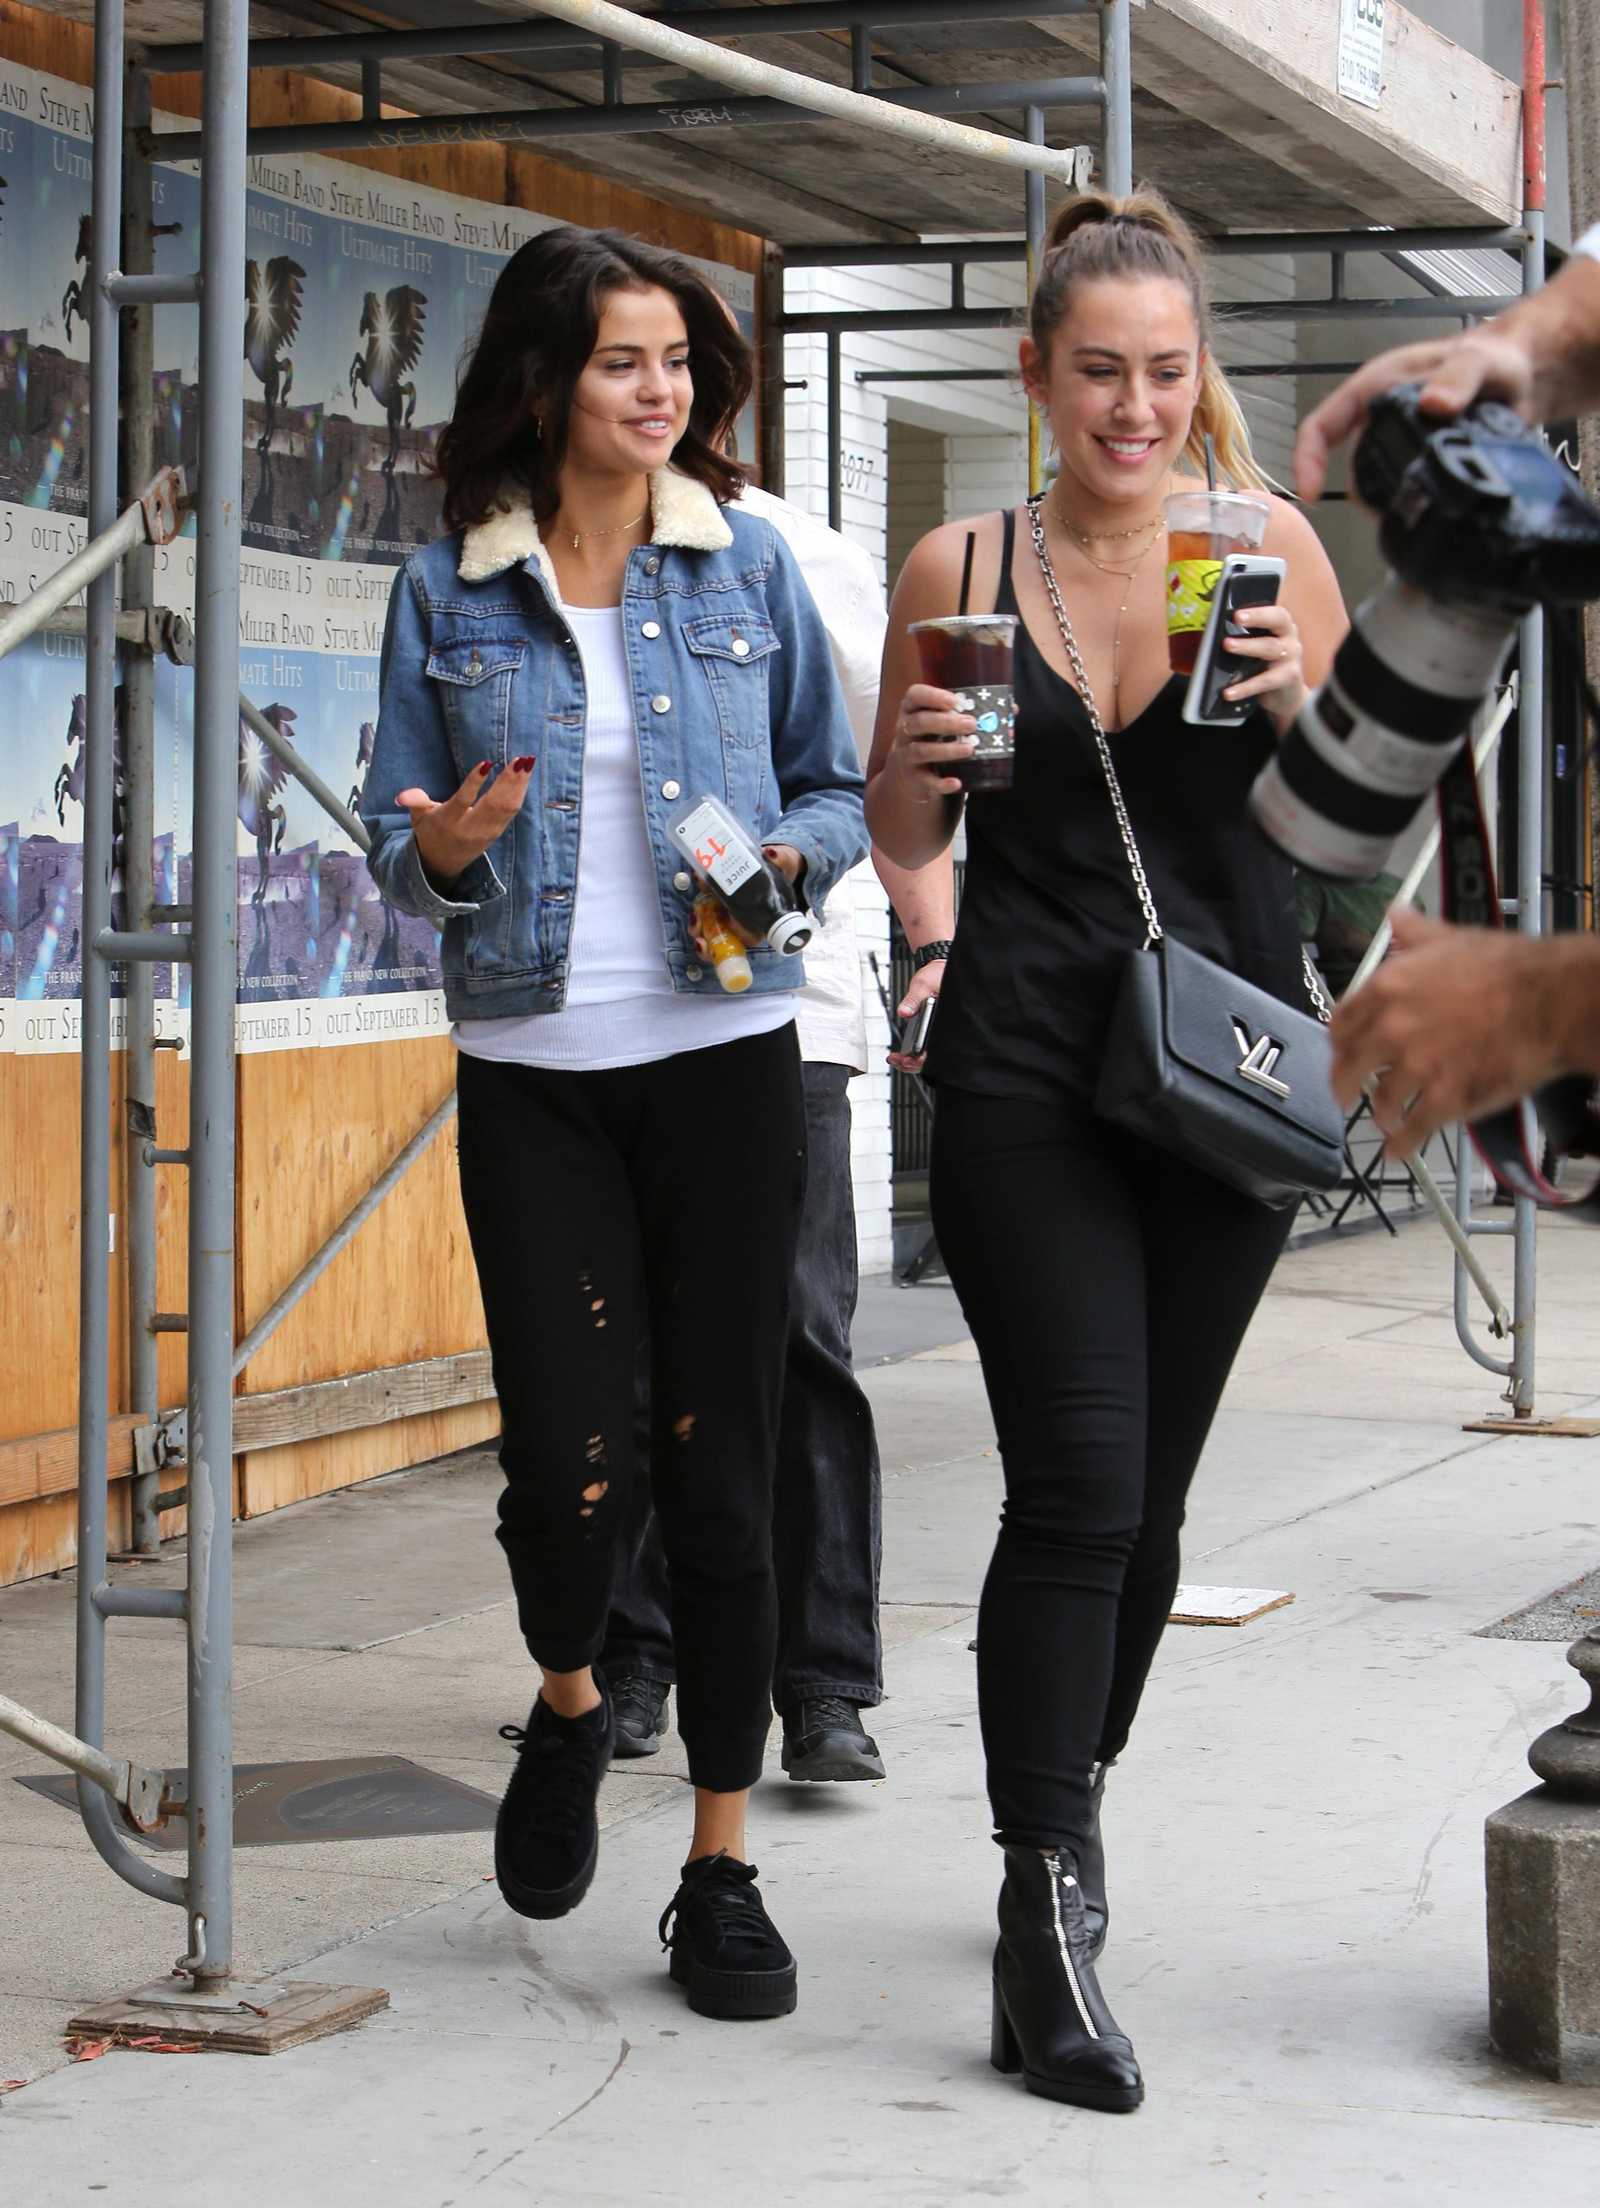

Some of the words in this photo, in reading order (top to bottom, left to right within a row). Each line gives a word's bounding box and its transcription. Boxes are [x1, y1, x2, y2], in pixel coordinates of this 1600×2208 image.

[0, 82, 28, 111] AND
[297, 564, 312, 595] 15
[355, 570, 392, 601] SEPTE
[725, 860, 752, 886] JUICE
[297, 1008, 312, 1036] 15
[424, 997, 441, 1026] 15
